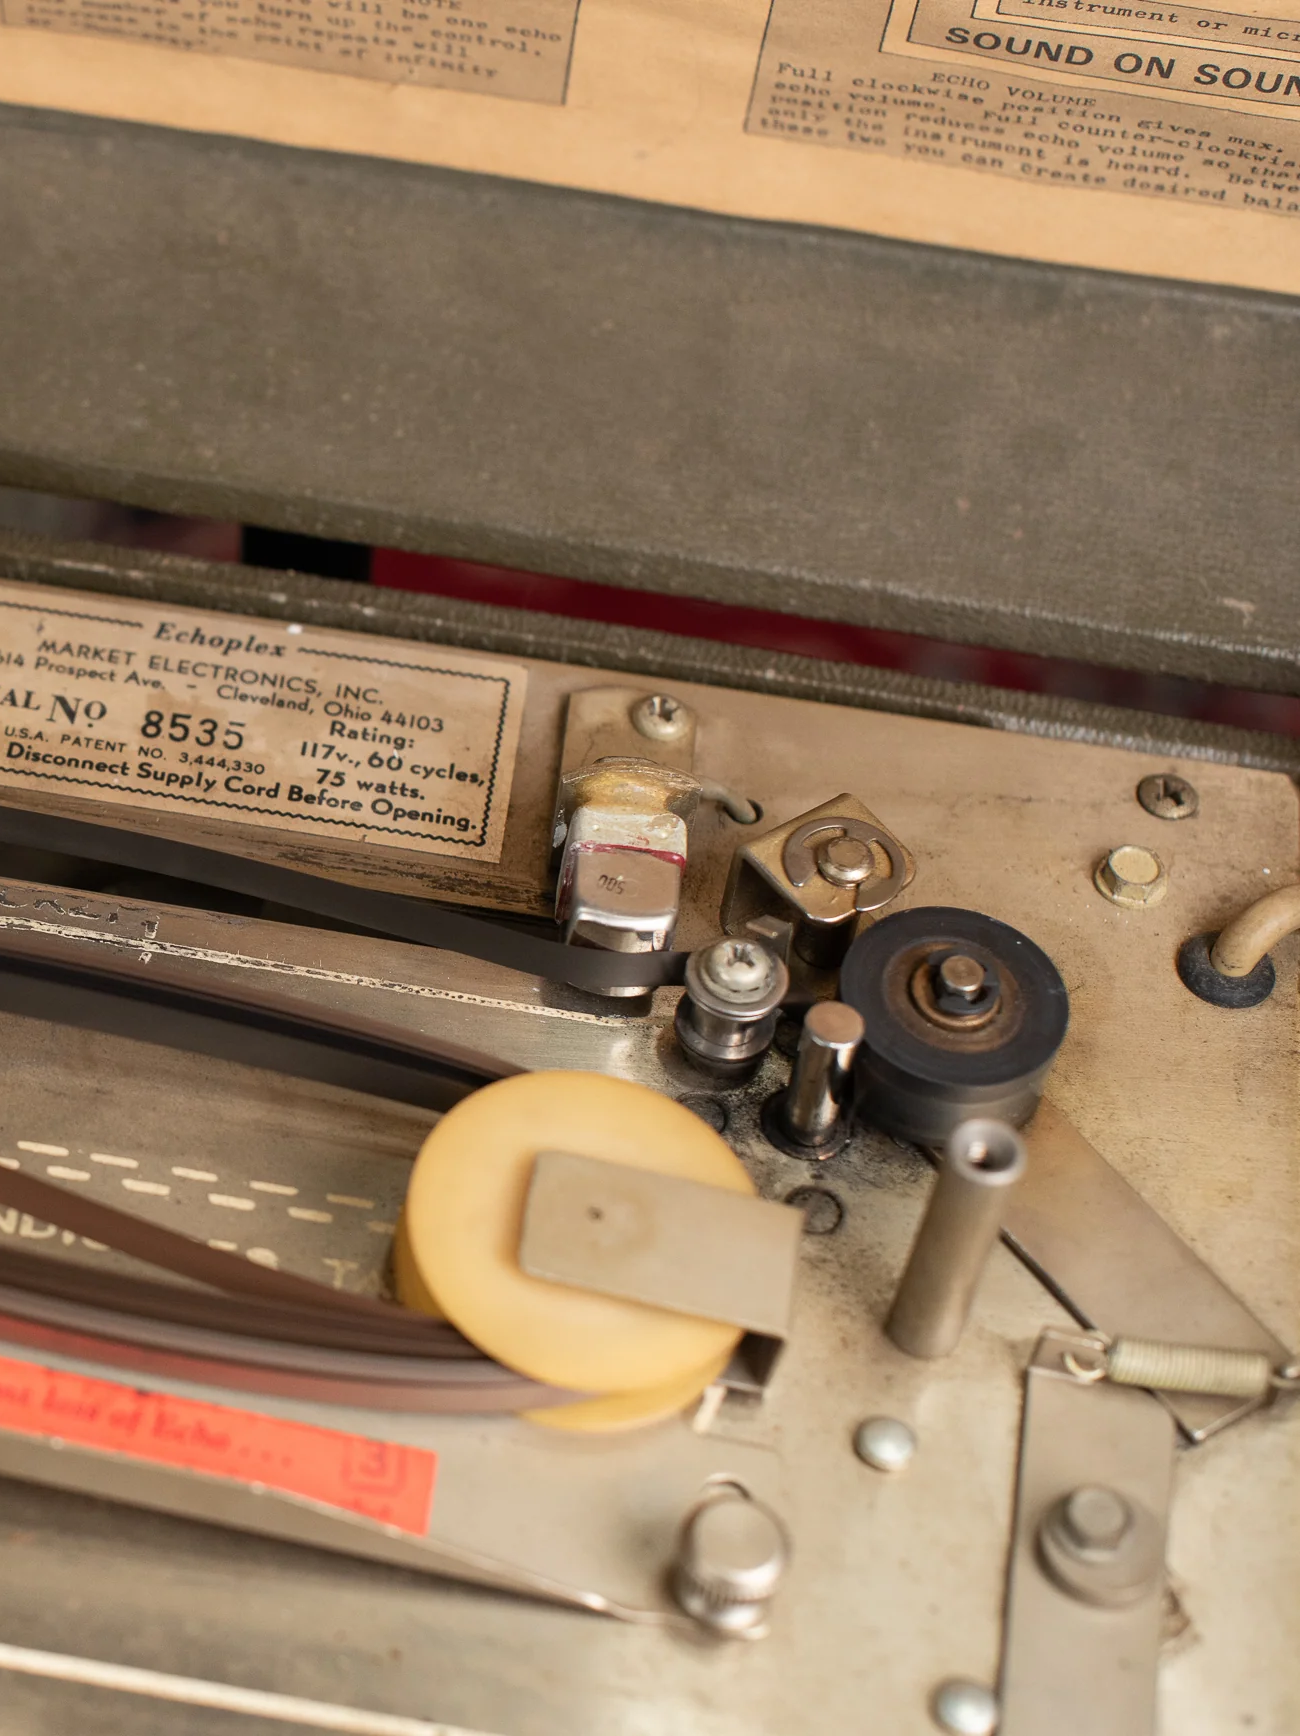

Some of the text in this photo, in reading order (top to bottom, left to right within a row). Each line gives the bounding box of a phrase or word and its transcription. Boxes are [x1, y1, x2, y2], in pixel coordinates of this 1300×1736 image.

[328, 2, 562, 43] will be one echo
[375, 20, 414, 34] the
[431, 28, 542, 57] control.
[1197, 19, 1228, 32] or
[413, 40, 468, 58] will
[945, 27, 1094, 66] SOUND
[1114, 52, 1176, 79] ON
[774, 80, 831, 97] echo
[848, 92, 946, 113] volume.
[984, 109, 1038, 126] Full
[778, 62, 1283, 154] Full clockwise position gives max.
[932, 72, 1097, 107] ECHO VOLUME
[767, 107, 826, 124] only
[845, 116, 884, 132] the
[904, 127, 1046, 160] instrument
[1064, 153, 1090, 168] is
[1107, 158, 1190, 180] heard.
[771, 94, 887, 118] position
[905, 111, 1005, 136] reduces
[1023, 129, 1080, 150] echo
[1098, 143, 1186, 163] volume
[1202, 158, 1230, 170] so
[760, 117, 829, 137] these
[847, 131, 887, 147] two
[903, 141, 946, 158] you
[961, 153, 1004, 169] can
[1123, 178, 1227, 202] desired
[154, 621, 288, 657] Echoplex
[37, 639, 384, 706] MARKET ELECTRONICS, INC.
[35, 656, 116, 682] Prospect
[124, 671, 166, 691] Ave.
[217, 684, 315, 716] Cleveland,
[323, 701, 372, 722] Ohio
[381, 711, 445, 733] 44103
[4, 725, 49, 743] U.S.A.
[60, 734, 128, 753] PATENT
[137, 745, 167, 761] NO.
[179, 752, 266, 776] 3,444,330
[141, 710, 247, 750] 8535
[330, 720, 415, 750] Rating:
[6, 742, 130, 776] Disconnect
[136, 762, 217, 793] Supply
[224, 775, 280, 799] Cord
[287, 784, 364, 812] Before
[371, 798, 477, 832] Opening.
[316, 768, 426, 801] 75 watts.
[368, 751, 404, 771] 60
[410, 763, 485, 787] cycles,
